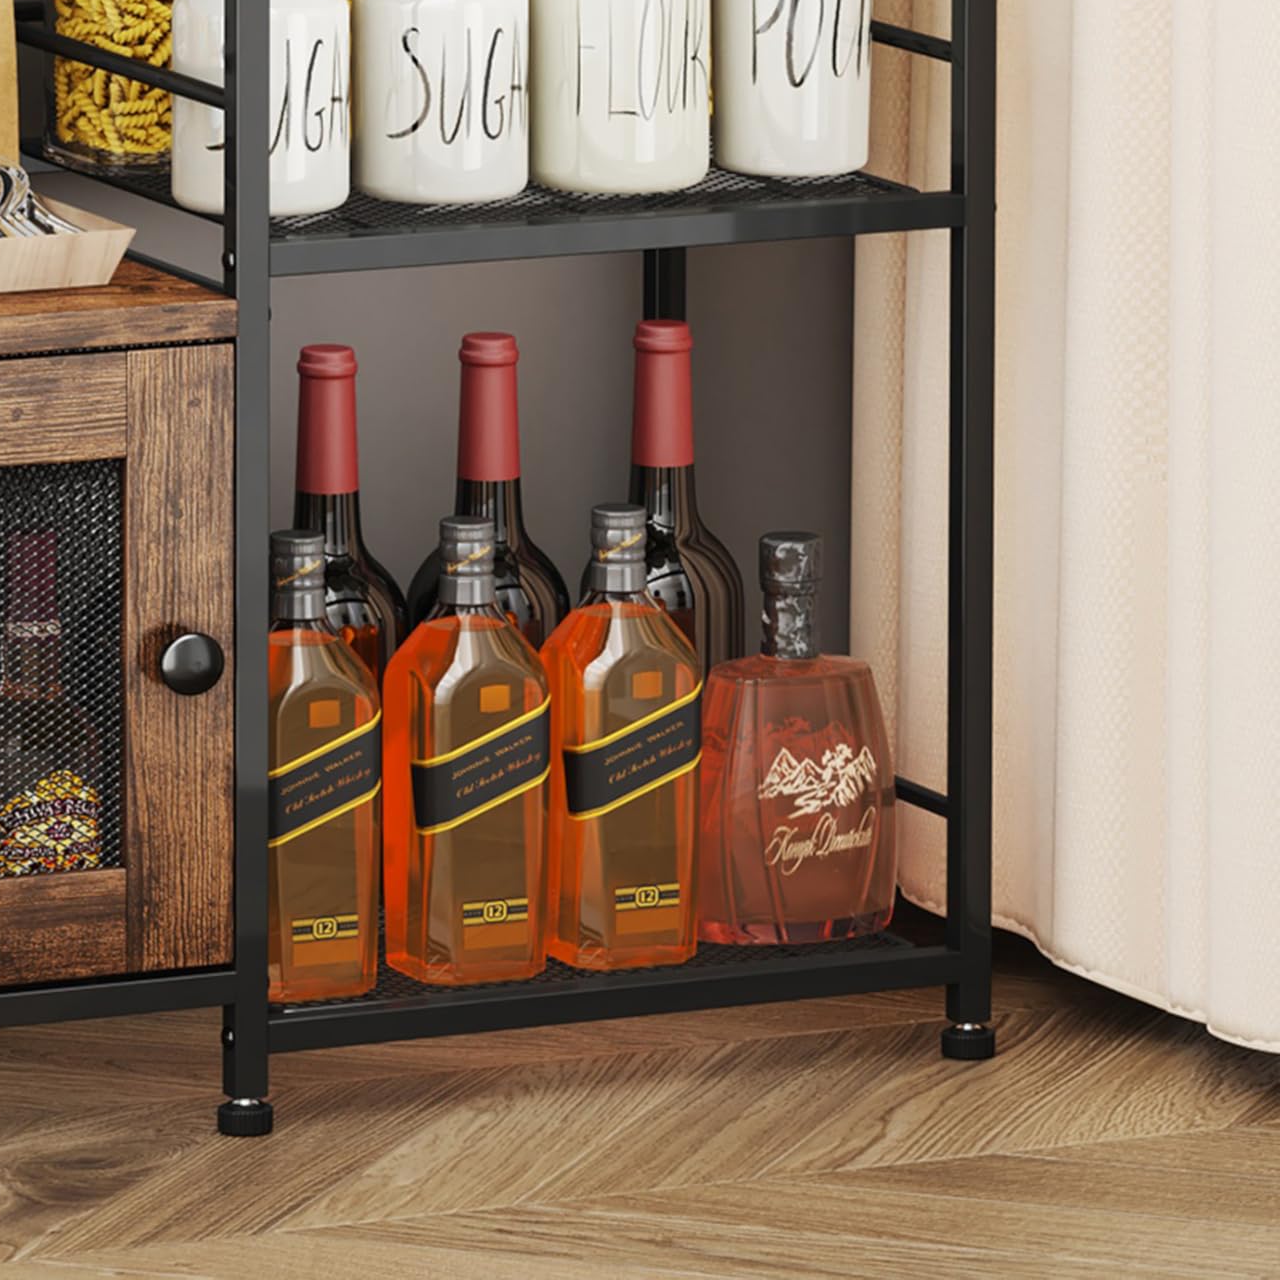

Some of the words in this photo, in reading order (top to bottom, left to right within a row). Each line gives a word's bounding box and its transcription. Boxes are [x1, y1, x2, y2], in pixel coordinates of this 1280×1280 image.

[386, 19, 529, 146] SUGA
[640, 891, 654, 902] 12
[489, 905, 502, 917] 12
[318, 922, 332, 934] 12
